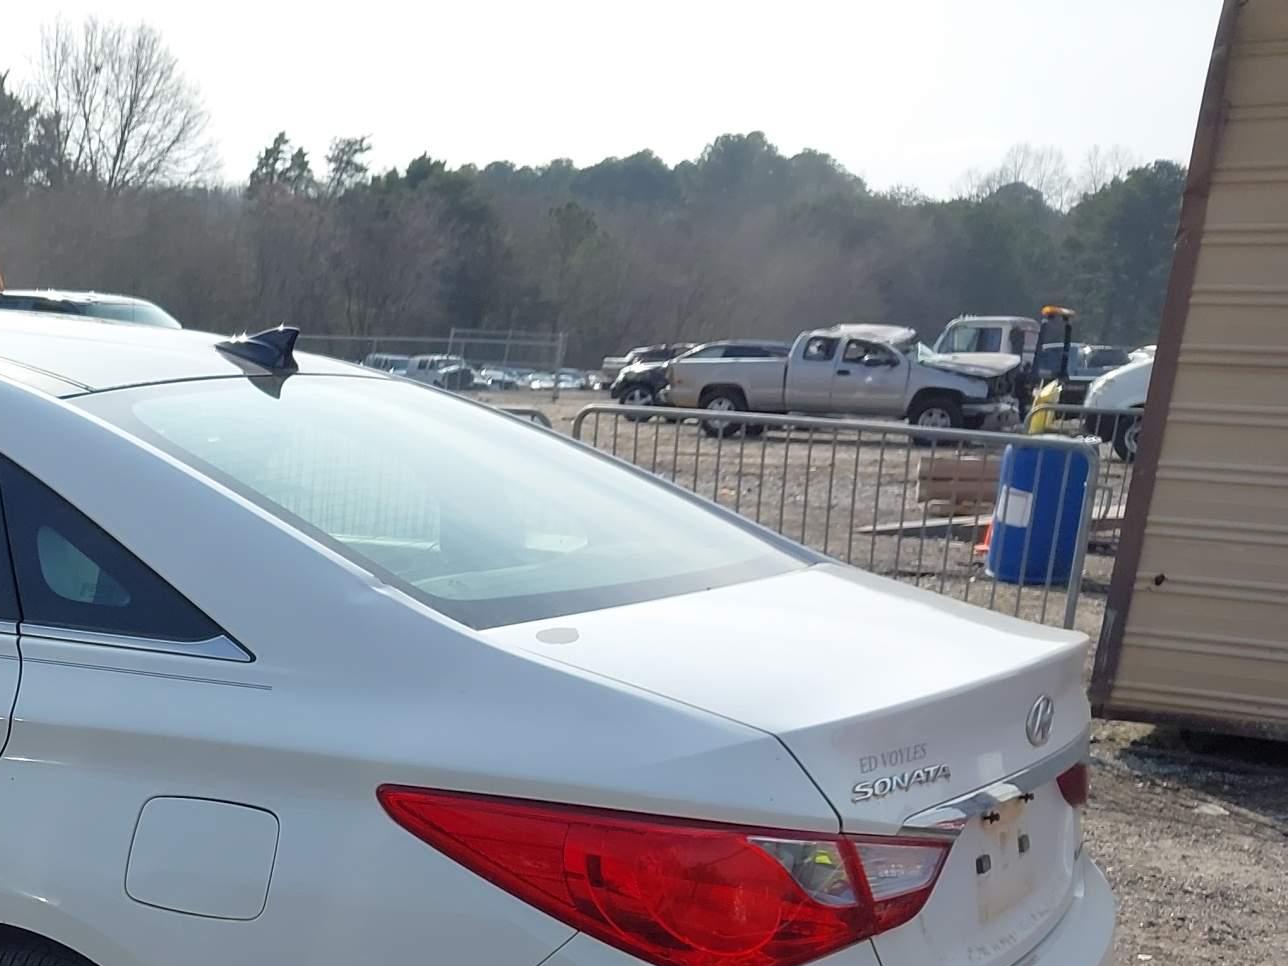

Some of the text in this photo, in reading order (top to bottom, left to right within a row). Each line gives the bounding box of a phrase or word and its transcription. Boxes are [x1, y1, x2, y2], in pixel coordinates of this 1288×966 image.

[859, 743, 928, 774] ED VOYLES
[851, 763, 951, 803] SONATA
